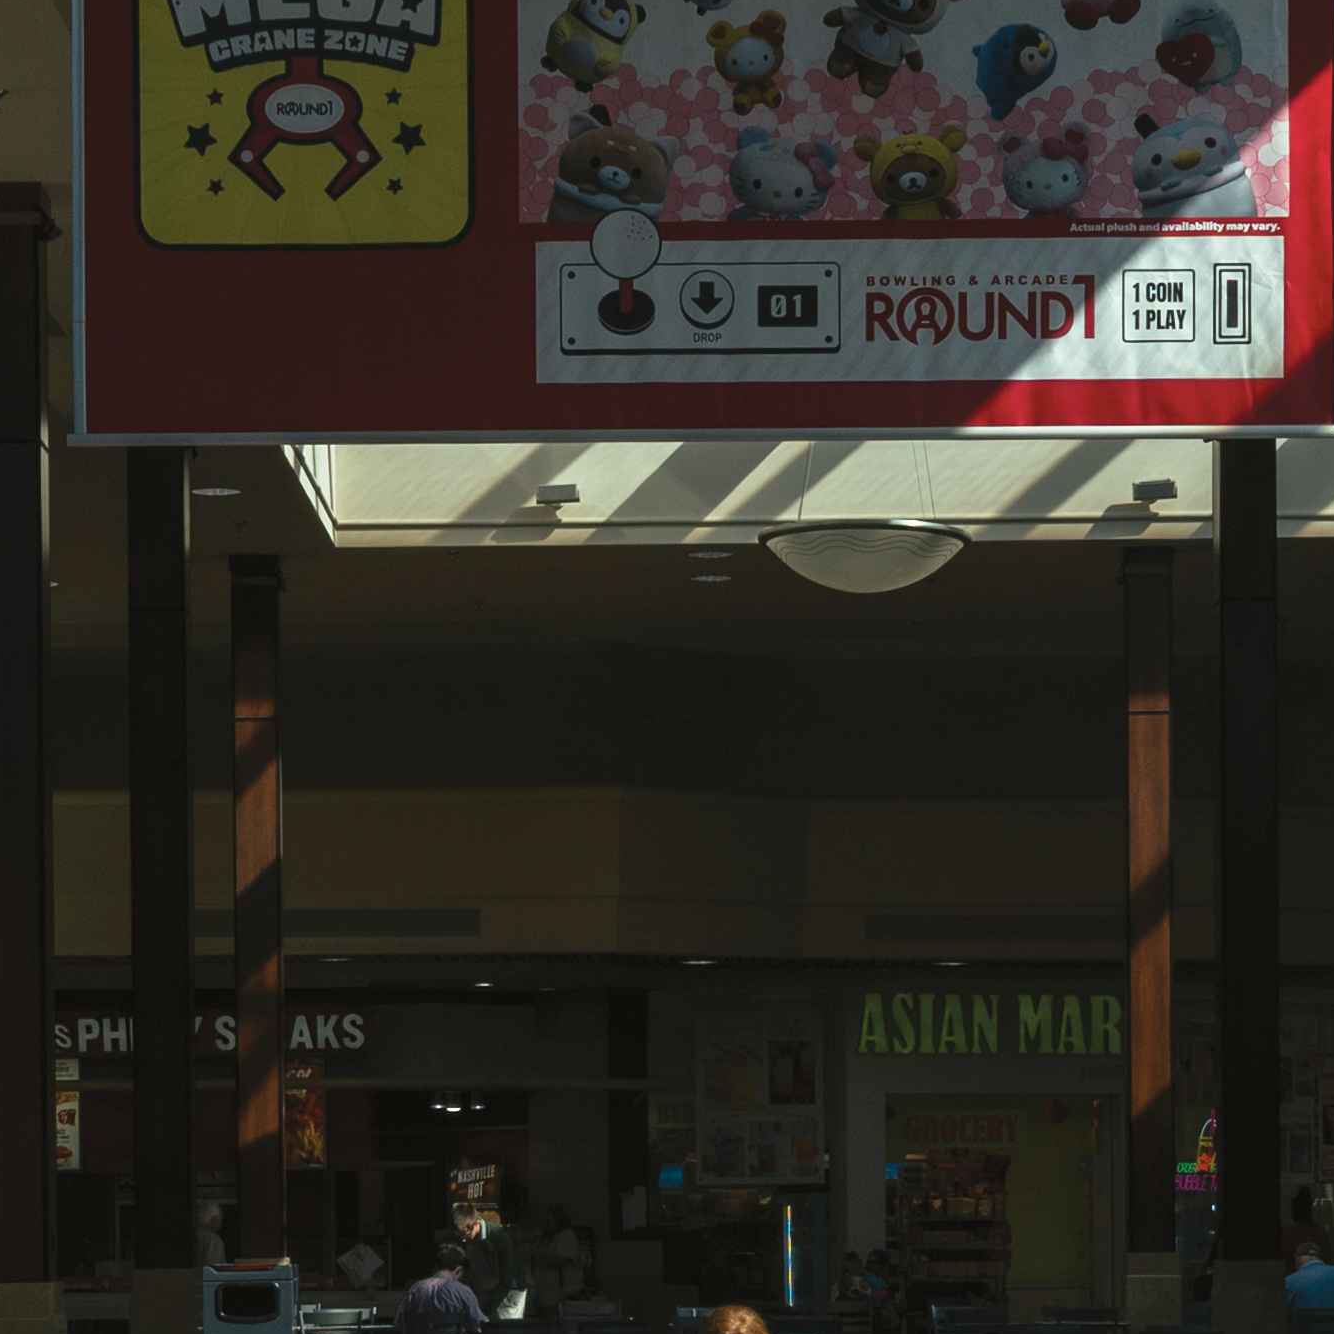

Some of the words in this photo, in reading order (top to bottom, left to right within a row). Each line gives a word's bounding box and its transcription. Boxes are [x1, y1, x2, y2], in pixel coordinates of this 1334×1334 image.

[208, 28, 315, 62] CRANE
[323, 28, 409, 62] ZONE
[1069, 222, 1104, 232] Actual
[1106, 222, 1137, 233] plush
[1138, 222, 1160, 232] and
[1161, 221, 1224, 233] availability
[1225, 222, 1249, 233] may
[1250, 223, 1281, 232] vary.
[867, 276, 956, 287] BOWLING
[968, 276, 978, 285] &
[991, 274, 1069, 286] ARCADE
[1132, 282, 1140, 302] 1
[1145, 282, 1184, 303] COIN
[769, 294, 803, 319] 01
[1132, 309, 1140, 330] 1
[1145, 309, 1187, 330] PLAY
[693, 332, 722, 343] DROP
[857, 991, 1001, 1056] ASIAN
[903, 1114, 1019, 1145] GROCERY
[457, 1164, 496, 1184] NASHVILLE
[1174, 1174, 1207, 1192] BUBBLE
[467, 1180, 485, 1199] HOT
